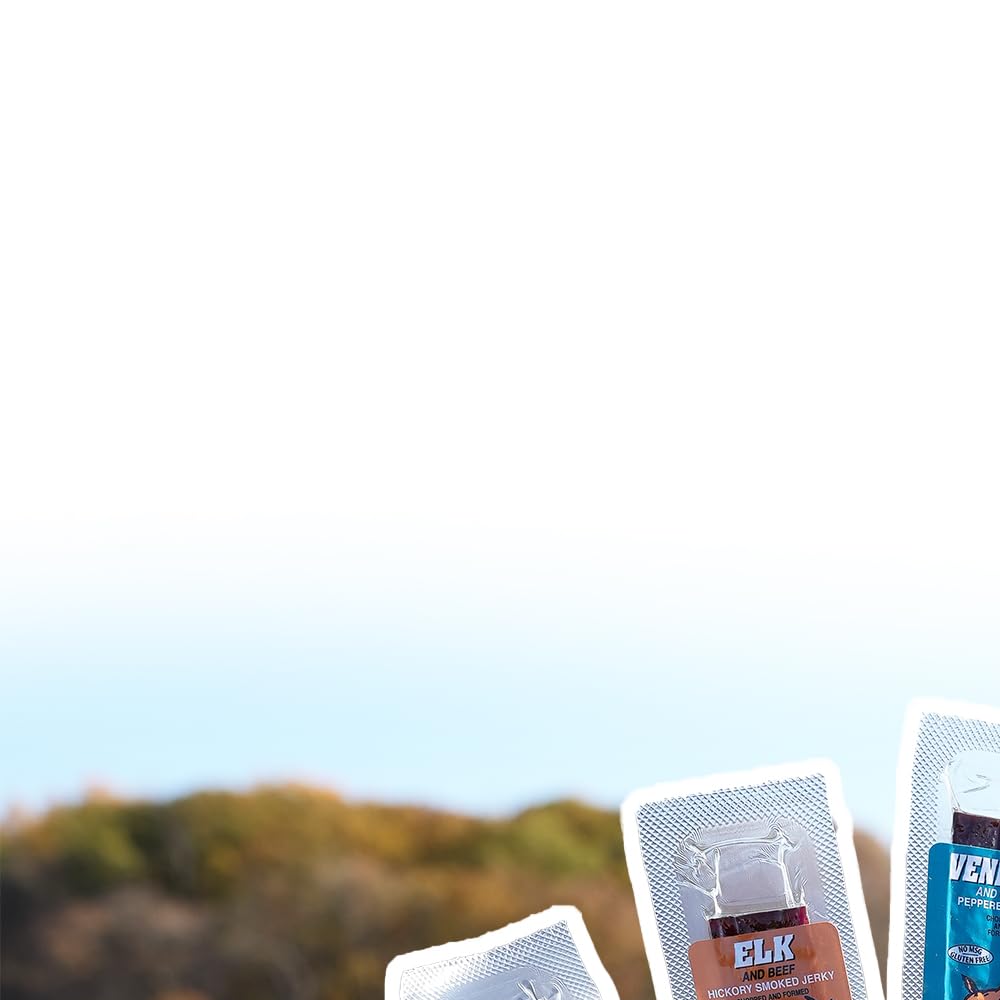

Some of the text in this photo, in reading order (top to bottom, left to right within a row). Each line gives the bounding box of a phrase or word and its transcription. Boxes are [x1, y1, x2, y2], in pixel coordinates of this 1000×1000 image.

[975, 886, 997, 898] AND
[730, 932, 798, 970] ELK
[958, 943, 982, 954] NO MSG
[949, 951, 989, 964] GLUTEN FREE
[741, 964, 795, 981] AND BEEF
[707, 970, 835, 999] HICKORY SMOKED JERKY
[768, 992, 781, 1000] AND
[782, 988, 809, 997] FORMED
